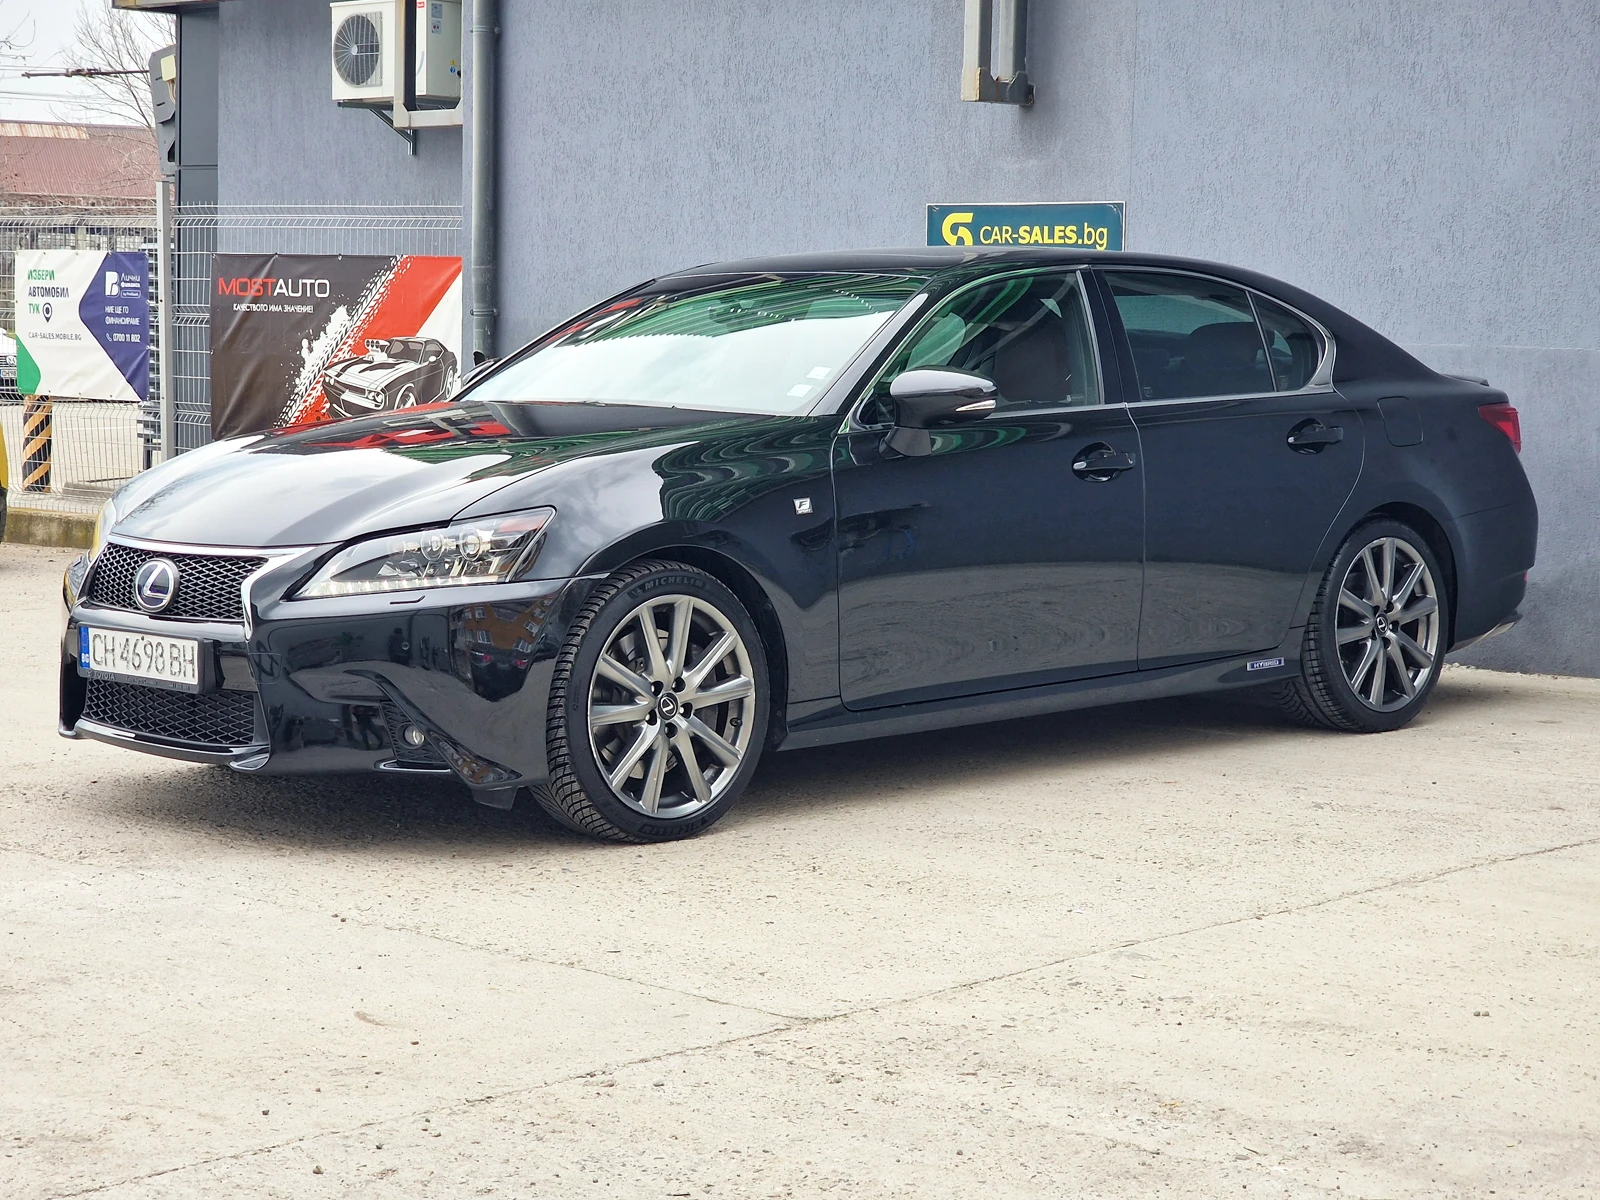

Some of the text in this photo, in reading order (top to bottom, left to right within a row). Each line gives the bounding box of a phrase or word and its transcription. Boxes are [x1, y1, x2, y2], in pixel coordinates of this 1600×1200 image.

[979, 222, 1108, 250] CAR-SALES.bg
[27, 269, 55, 281] ИЗБЕРИ
[28, 286, 69, 298] АВТОМОБИЛ
[218, 277, 330, 298] MOSTAUTO
[28, 303, 40, 314] ТУК
[105, 305, 114, 314] НИЕ
[233, 303, 314, 313] КАЧЕСТВОТО ИМА ЗНАЧЕНИЕ!
[105, 316, 140, 326] ФИНАНСИРАМЕ
[28, 332, 82, 341] CAR-SALES.MOBILE.BG
[113, 333, 125, 342] 0700
[645, 576, 703, 590] MICHELIN
